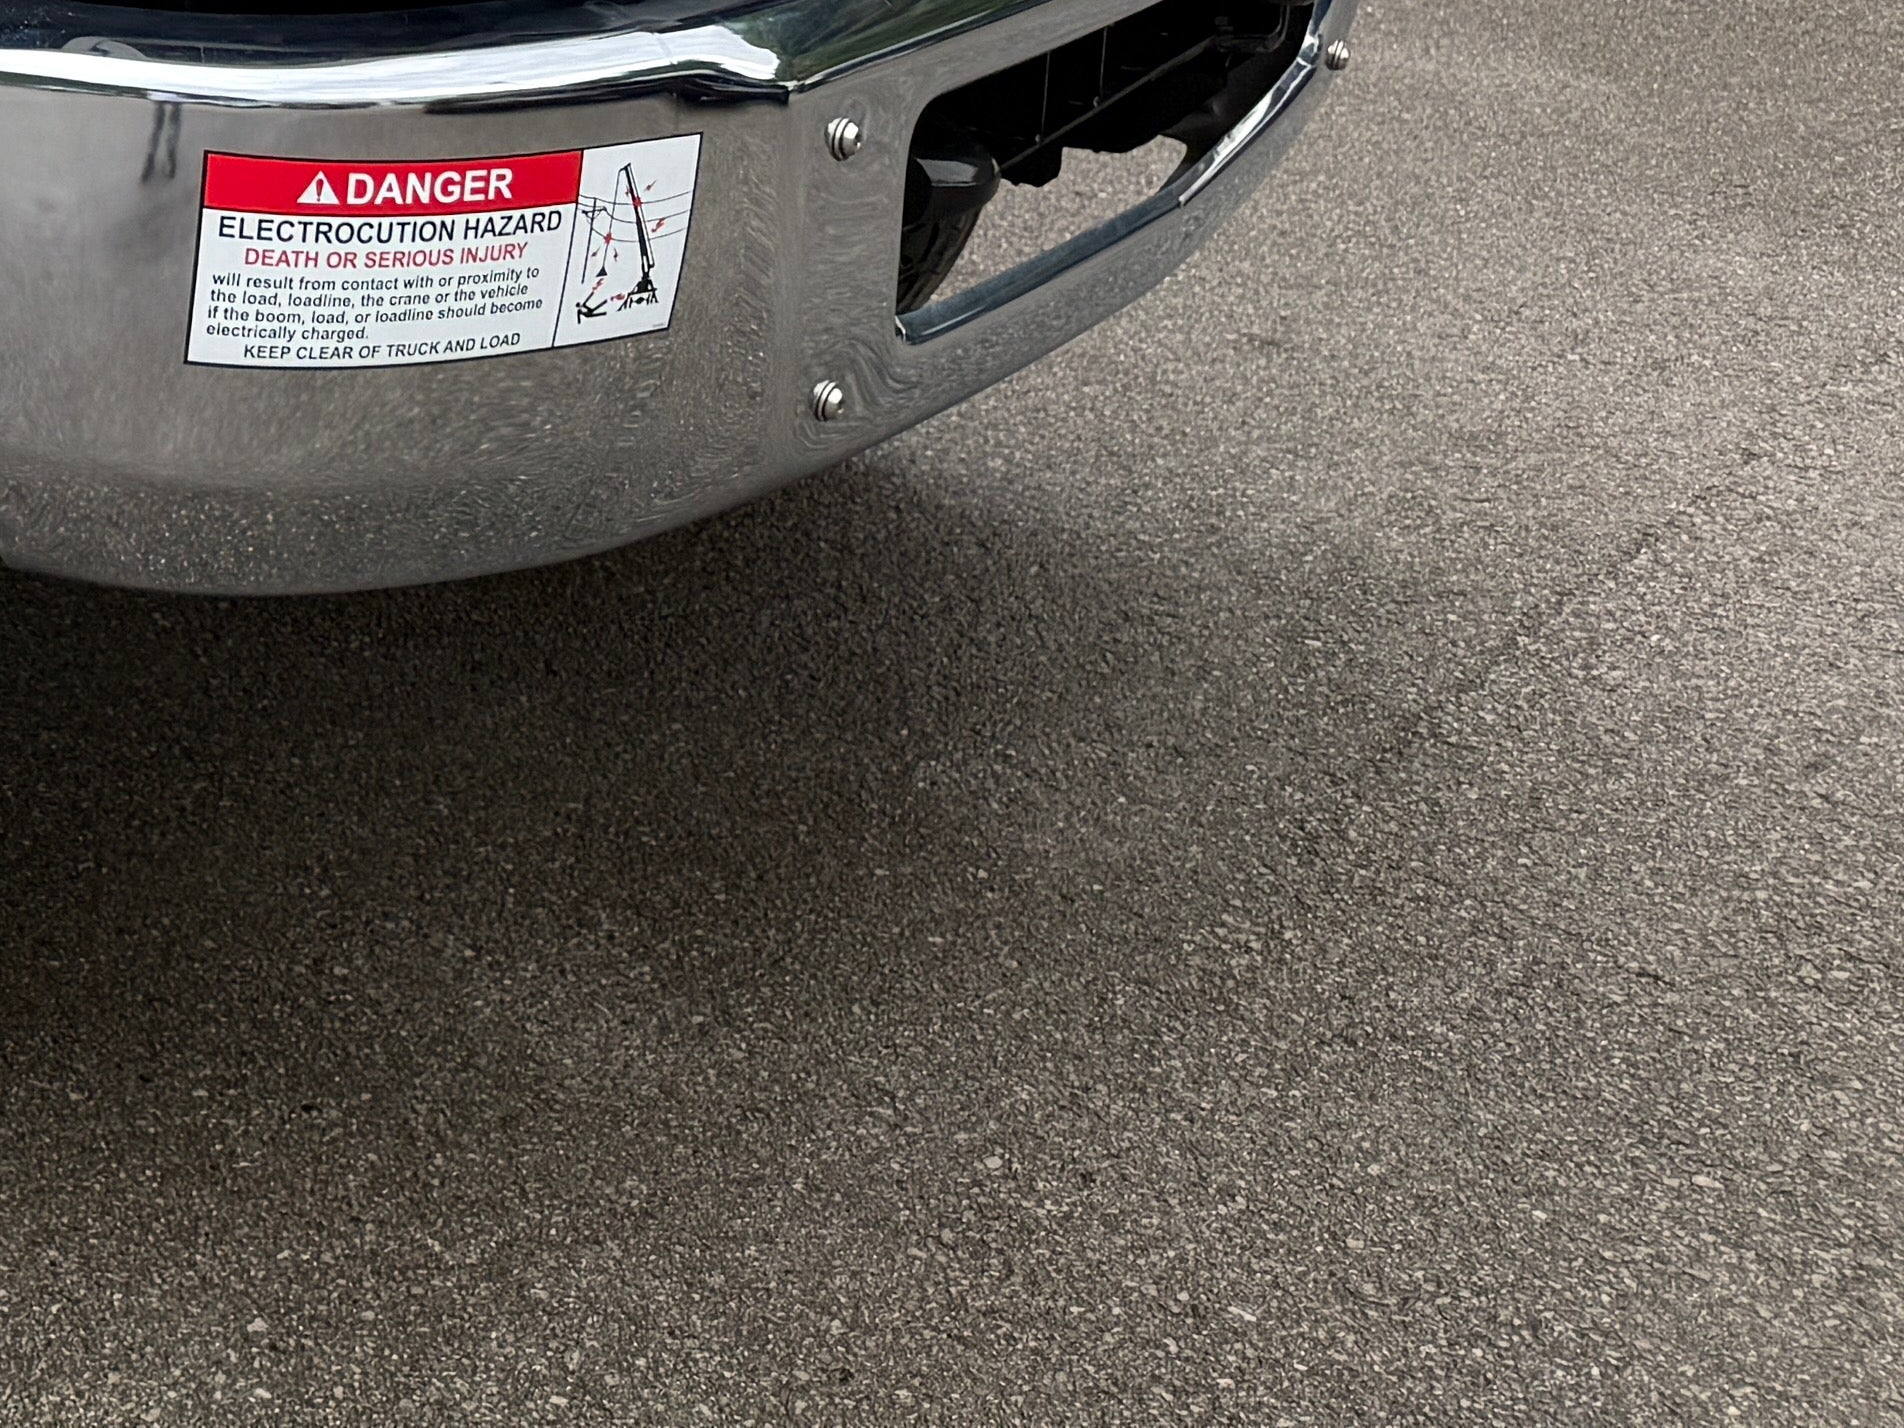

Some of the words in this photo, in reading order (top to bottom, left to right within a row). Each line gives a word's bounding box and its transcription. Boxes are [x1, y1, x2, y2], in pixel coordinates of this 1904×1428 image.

[345, 167, 514, 206] DANGER
[218, 215, 455, 244] ELECTROCUTION
[463, 210, 563, 241] HAZARD
[244, 247, 320, 269] DEATH
[326, 251, 358, 269] OR
[363, 248, 454, 269] SERIOUS
[460, 241, 529, 265] INJURY
[212, 272, 241, 287] will
[246, 276, 294, 290] result
[298, 276, 336, 291] from
[341, 277, 399, 291] contact
[403, 275, 434, 290] with
[438, 276, 454, 288] or
[457, 267, 522, 289] proximity
[526, 266, 540, 279] to
[210, 289, 237, 304] the
[242, 291, 282, 308] load,
[288, 293, 355, 309] loadline,
[360, 294, 384, 307] the
[389, 294, 430, 307] crane
[435, 291, 449, 304] or
[454, 289, 476, 302] the
[480, 283, 529, 300] vehicle
[207, 305, 219, 319] if
[223, 306, 249, 322] the
[255, 309, 305, 325] boom,
[311, 310, 349, 326] load,
[354, 312, 371, 323] or
[375, 307, 433, 323] loadline
[438, 303, 487, 320] should
[490, 298, 543, 315] become
[206, 323, 296, 343] electrically
[301, 326, 369, 343] charged.
[243, 344, 292, 360] KEEP
[295, 346, 354, 361] CLEAR
[358, 344, 382, 359] OF
[387, 341, 441, 357] TRUCK
[443, 337, 477, 354] AND
[480, 332, 522, 350] LOAD
